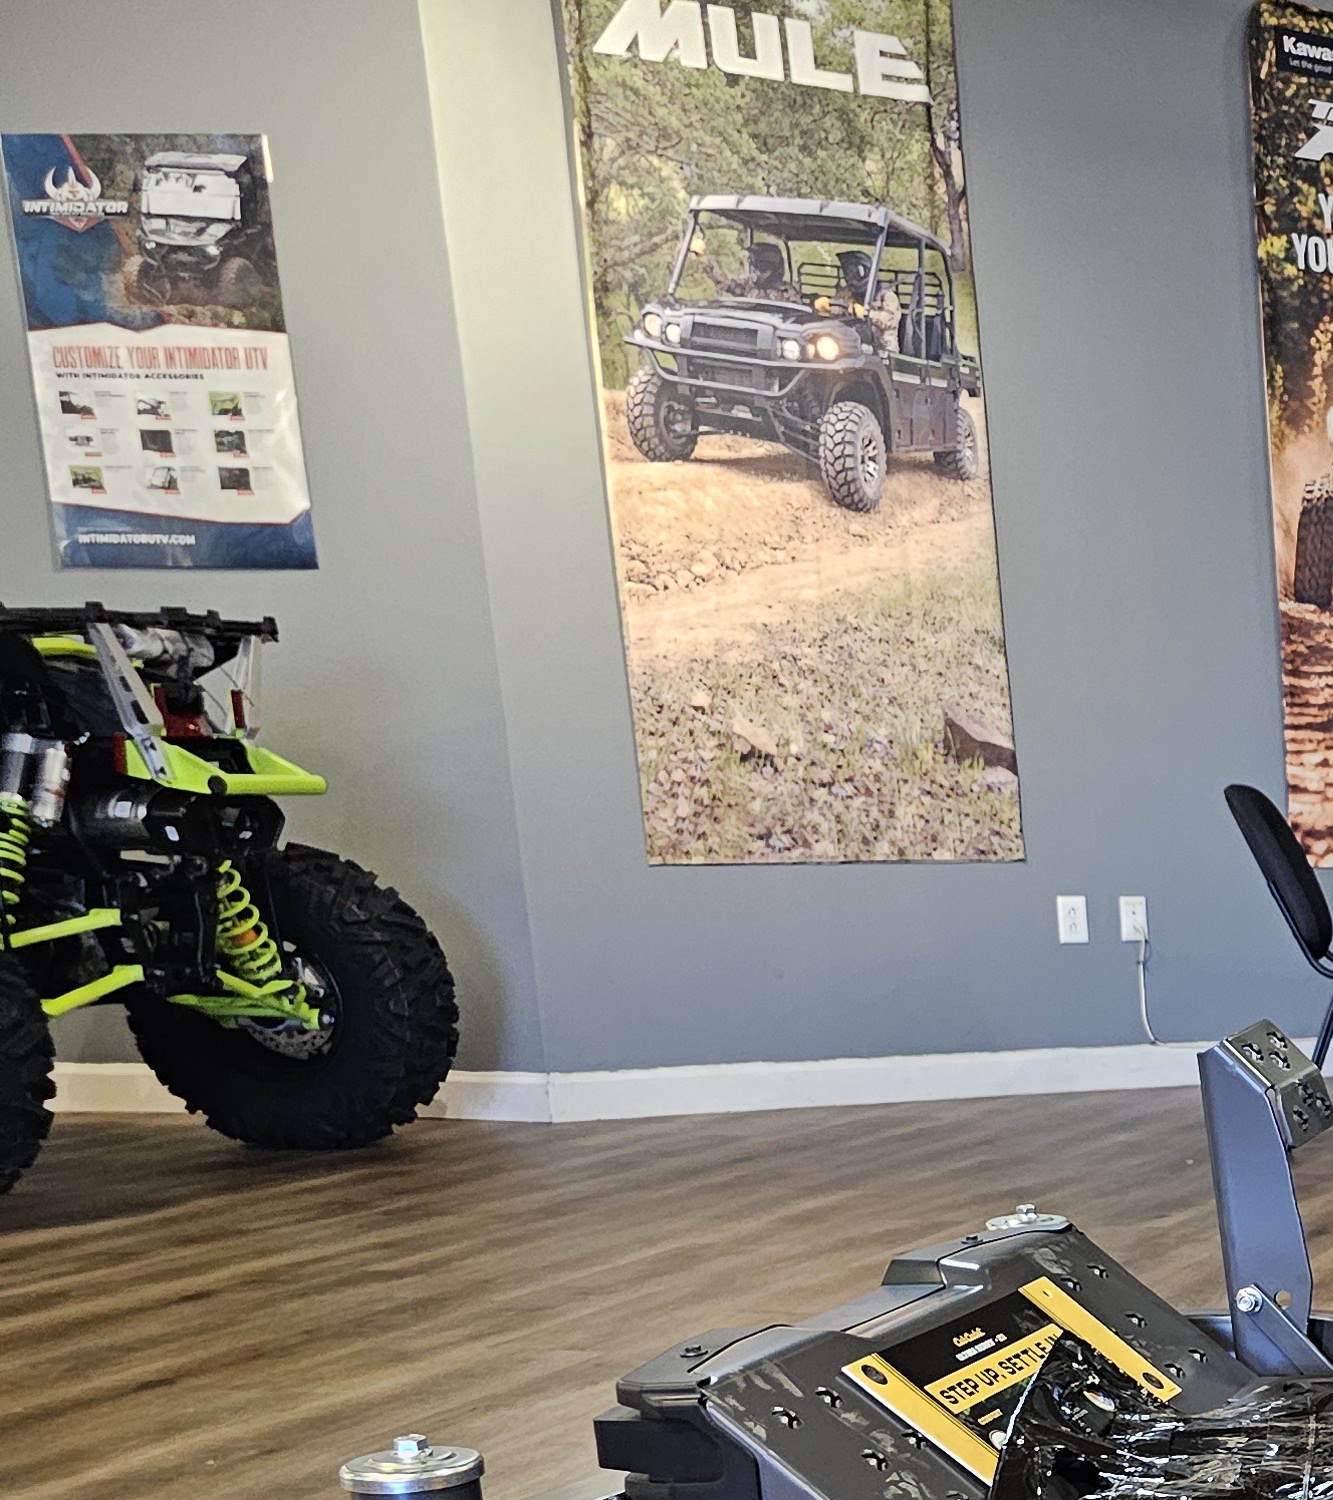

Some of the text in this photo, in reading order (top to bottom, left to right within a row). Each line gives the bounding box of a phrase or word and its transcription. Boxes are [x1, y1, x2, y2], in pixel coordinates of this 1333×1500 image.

[592, 0, 935, 105] MULE
[22, 200, 128, 213] INTIMIDATOR
[52, 346, 268, 371] CUSTOMIZE YOUR INTIMIDATOR UTV
[939, 1378, 979, 1405] STEP
[998, 1341, 1048, 1376] SETTLE
